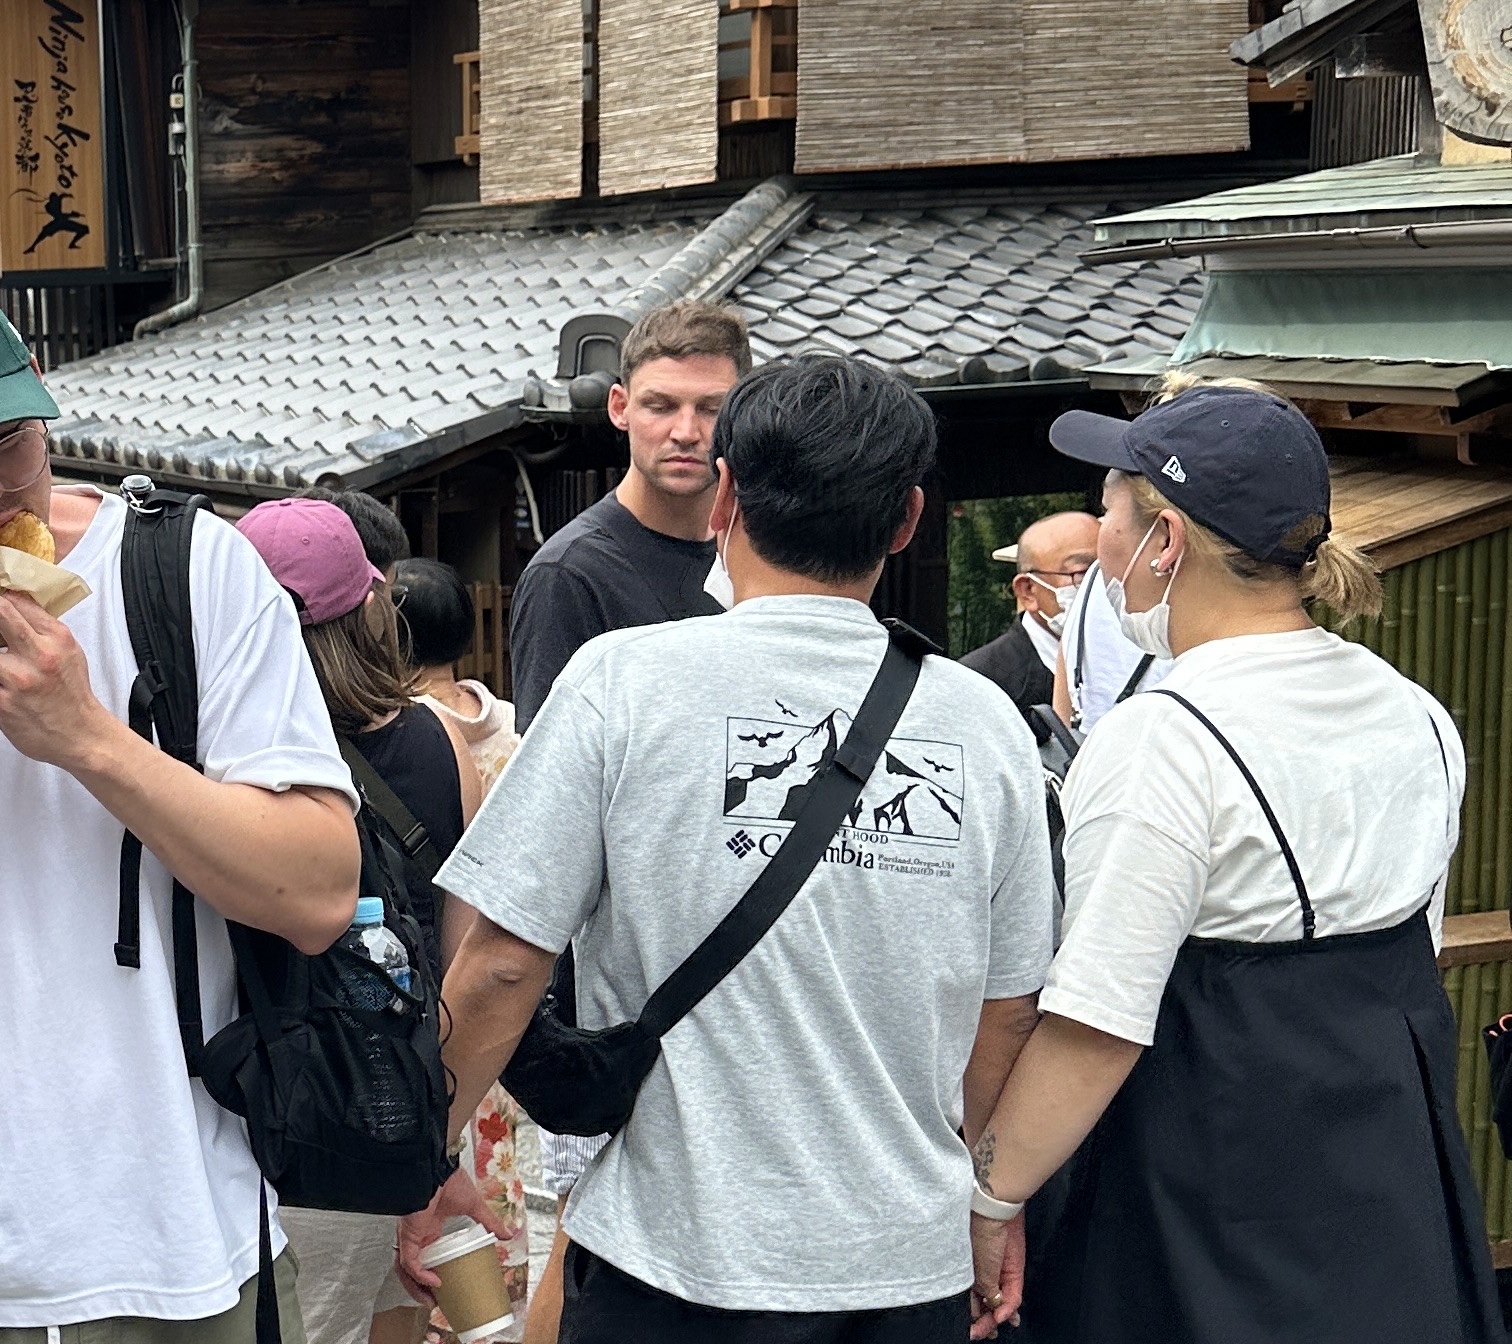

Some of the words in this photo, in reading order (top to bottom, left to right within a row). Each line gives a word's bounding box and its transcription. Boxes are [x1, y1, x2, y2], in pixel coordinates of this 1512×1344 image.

[44, 123, 90, 189] Kyoto
[758, 832, 875, 869] Cmbia
[852, 831, 889, 845] HOOD
